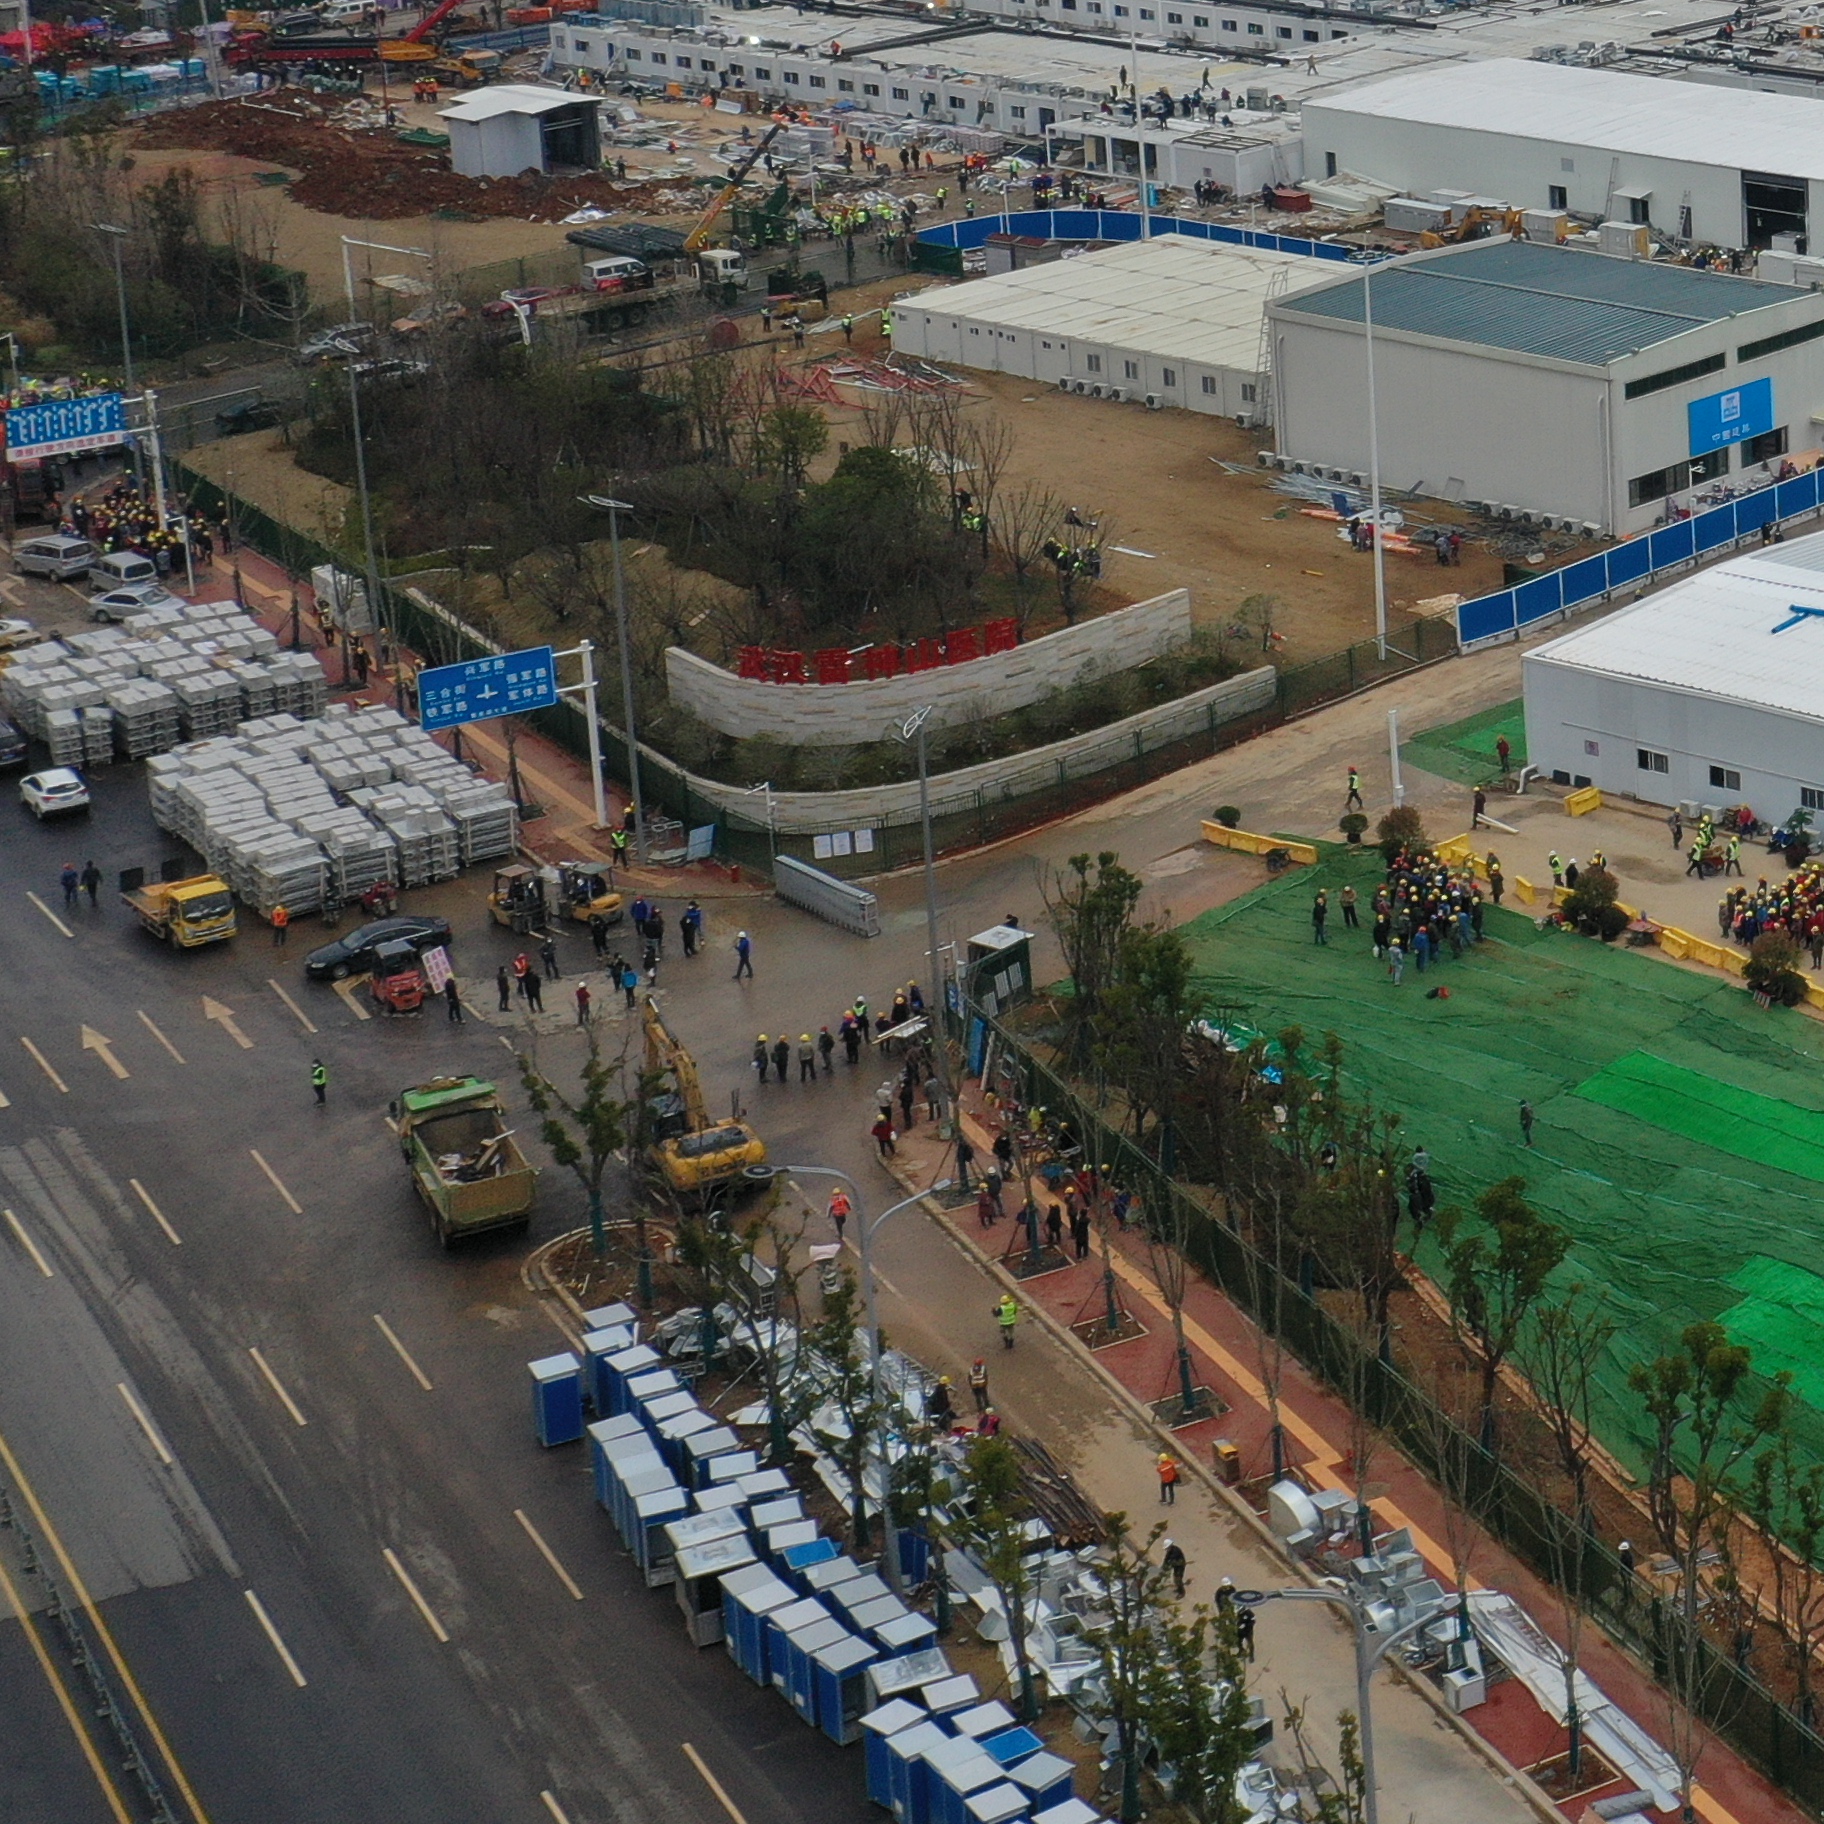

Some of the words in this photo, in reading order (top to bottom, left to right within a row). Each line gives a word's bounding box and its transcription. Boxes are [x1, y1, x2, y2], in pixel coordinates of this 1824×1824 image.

[737, 617, 1020, 686] 武汉雷神山医院
